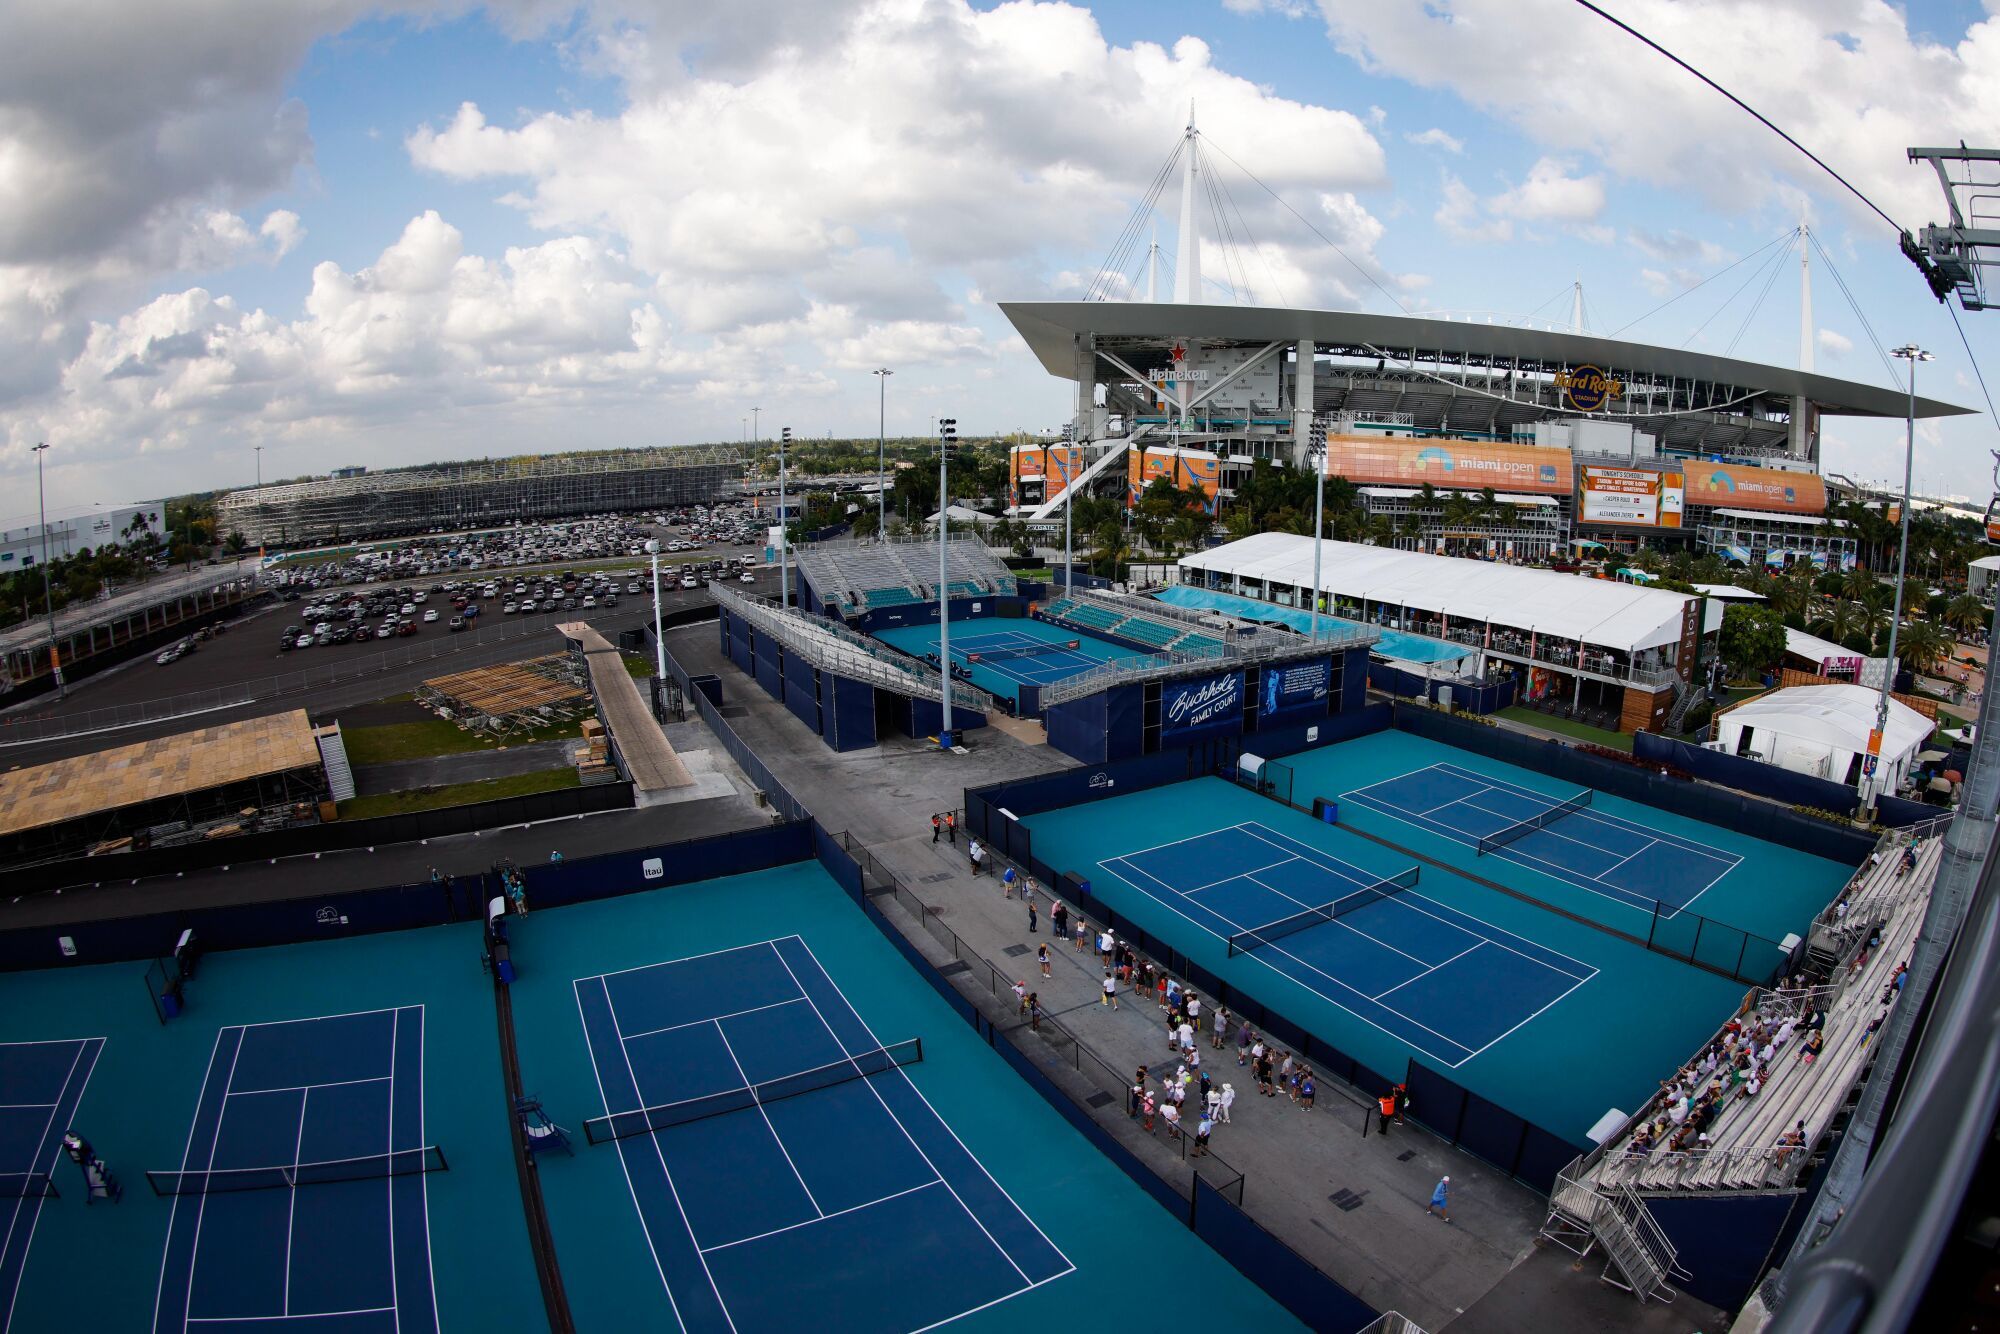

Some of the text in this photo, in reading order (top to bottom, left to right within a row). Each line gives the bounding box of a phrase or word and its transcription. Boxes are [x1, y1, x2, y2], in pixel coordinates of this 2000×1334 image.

[1148, 368, 1209, 381] Heineken
[1553, 371, 1622, 400] Hard Rock
[1575, 394, 1599, 402] STADIUM
[1460, 456, 1534, 474] miami open
[1601, 470, 1623, 478] TONIGHT'S
[1738, 480, 1782, 496] miami open
[1599, 510, 1621, 518] ALEXANDER
[1190, 692, 1237, 727] FAMILY COURT
[645, 866, 662, 876] Itaú
